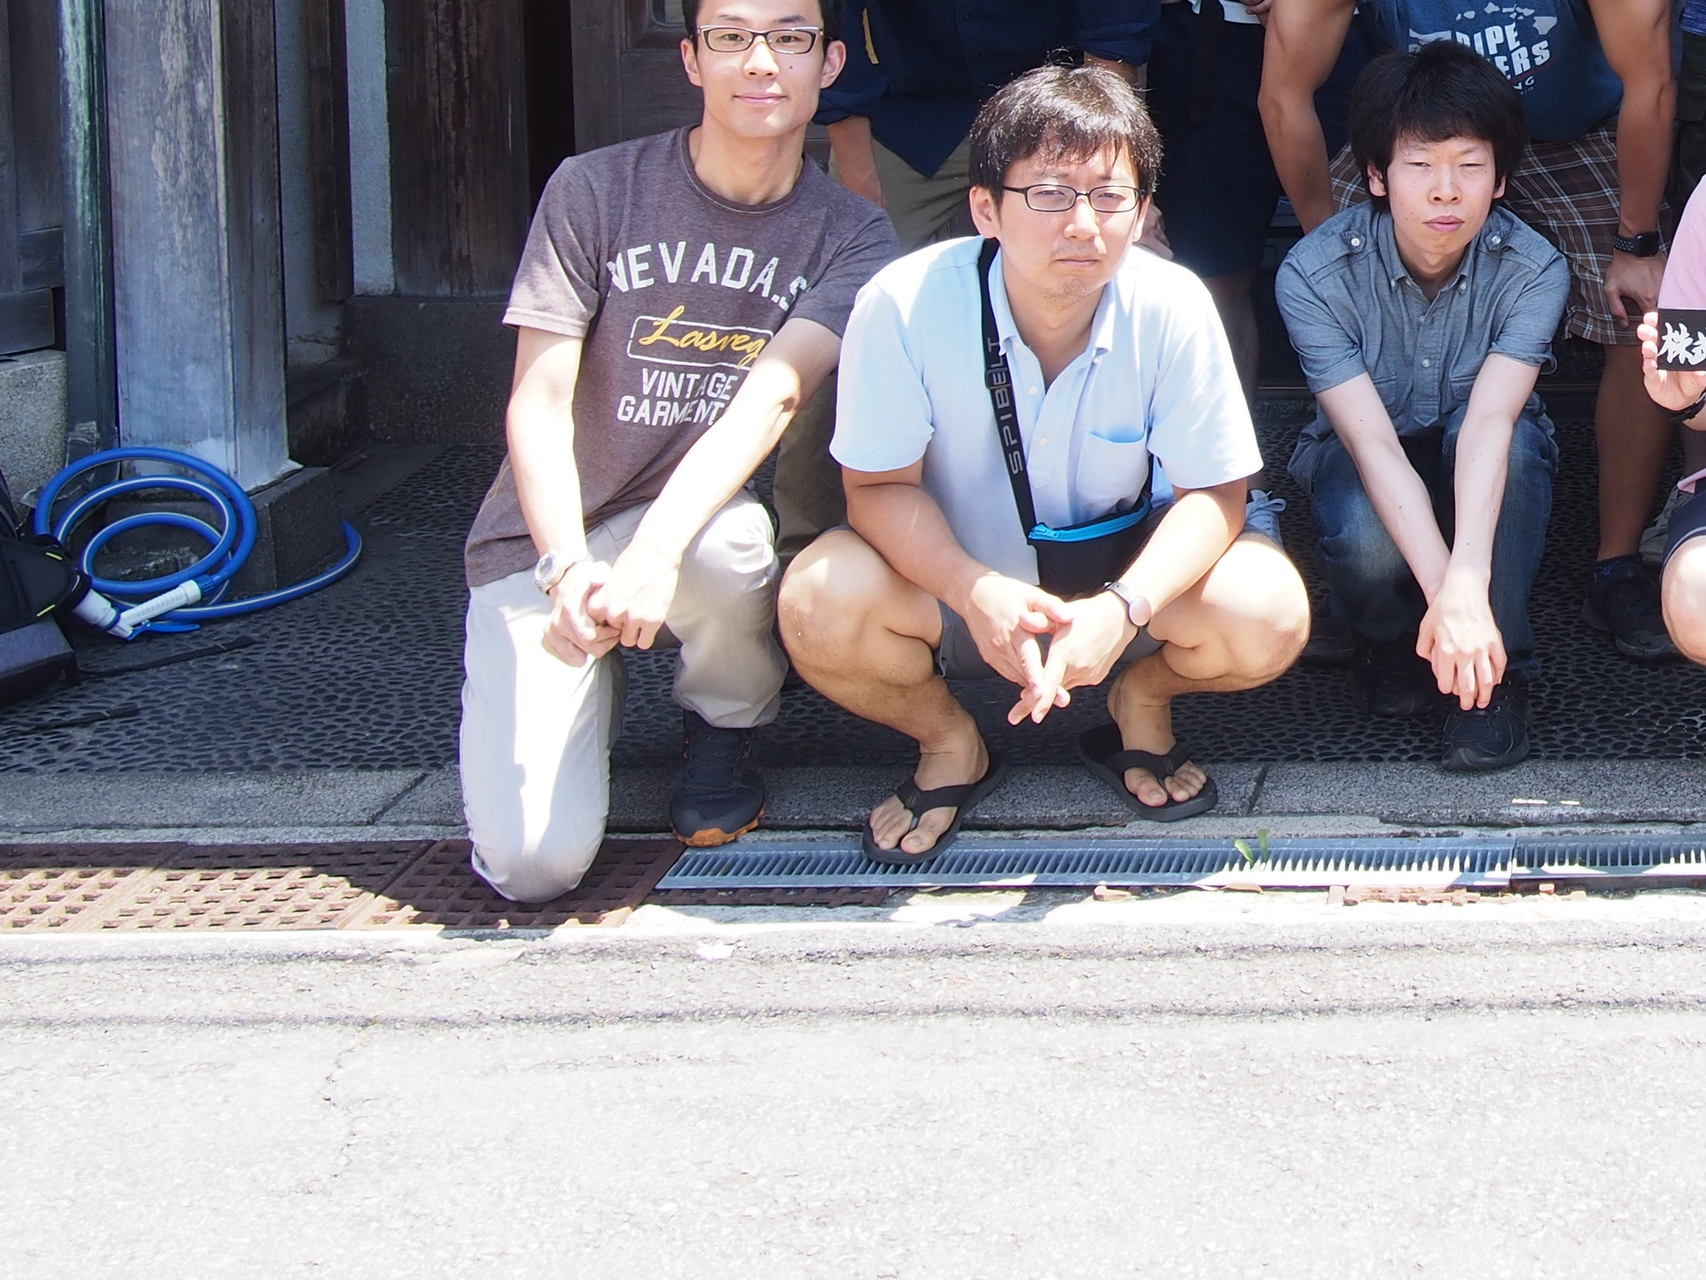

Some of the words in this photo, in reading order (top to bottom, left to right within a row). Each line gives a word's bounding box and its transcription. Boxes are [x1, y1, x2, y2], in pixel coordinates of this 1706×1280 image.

[1487, 40, 1551, 80] ERS
[641, 368, 739, 400] VINTAGE
[987, 337, 1024, 475] SPIBELT
